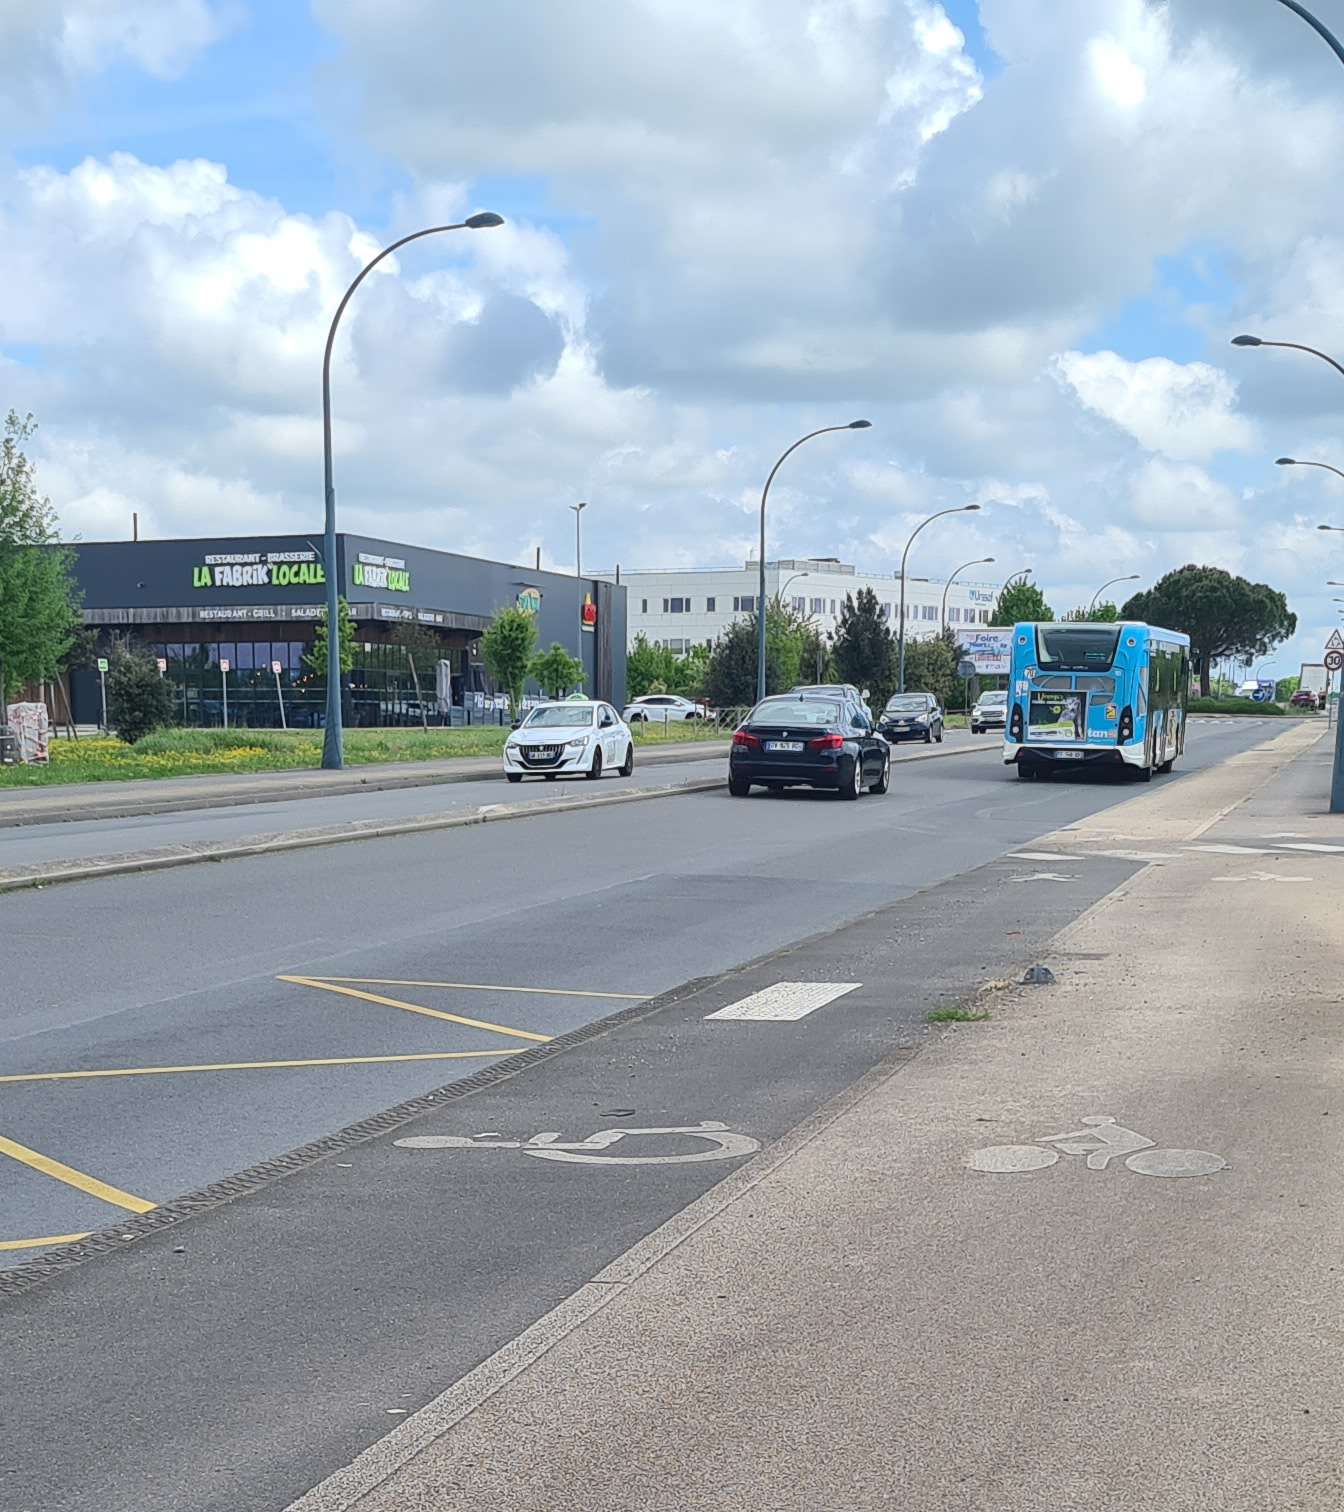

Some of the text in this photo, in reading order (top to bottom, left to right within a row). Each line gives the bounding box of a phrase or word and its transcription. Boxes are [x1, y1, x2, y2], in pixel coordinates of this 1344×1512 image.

[205, 554, 261, 565] RESTAURANT
[267, 551, 316, 563] BRASSERIE
[193, 566, 212, 587] LA
[271, 563, 326, 586] LOCALE
